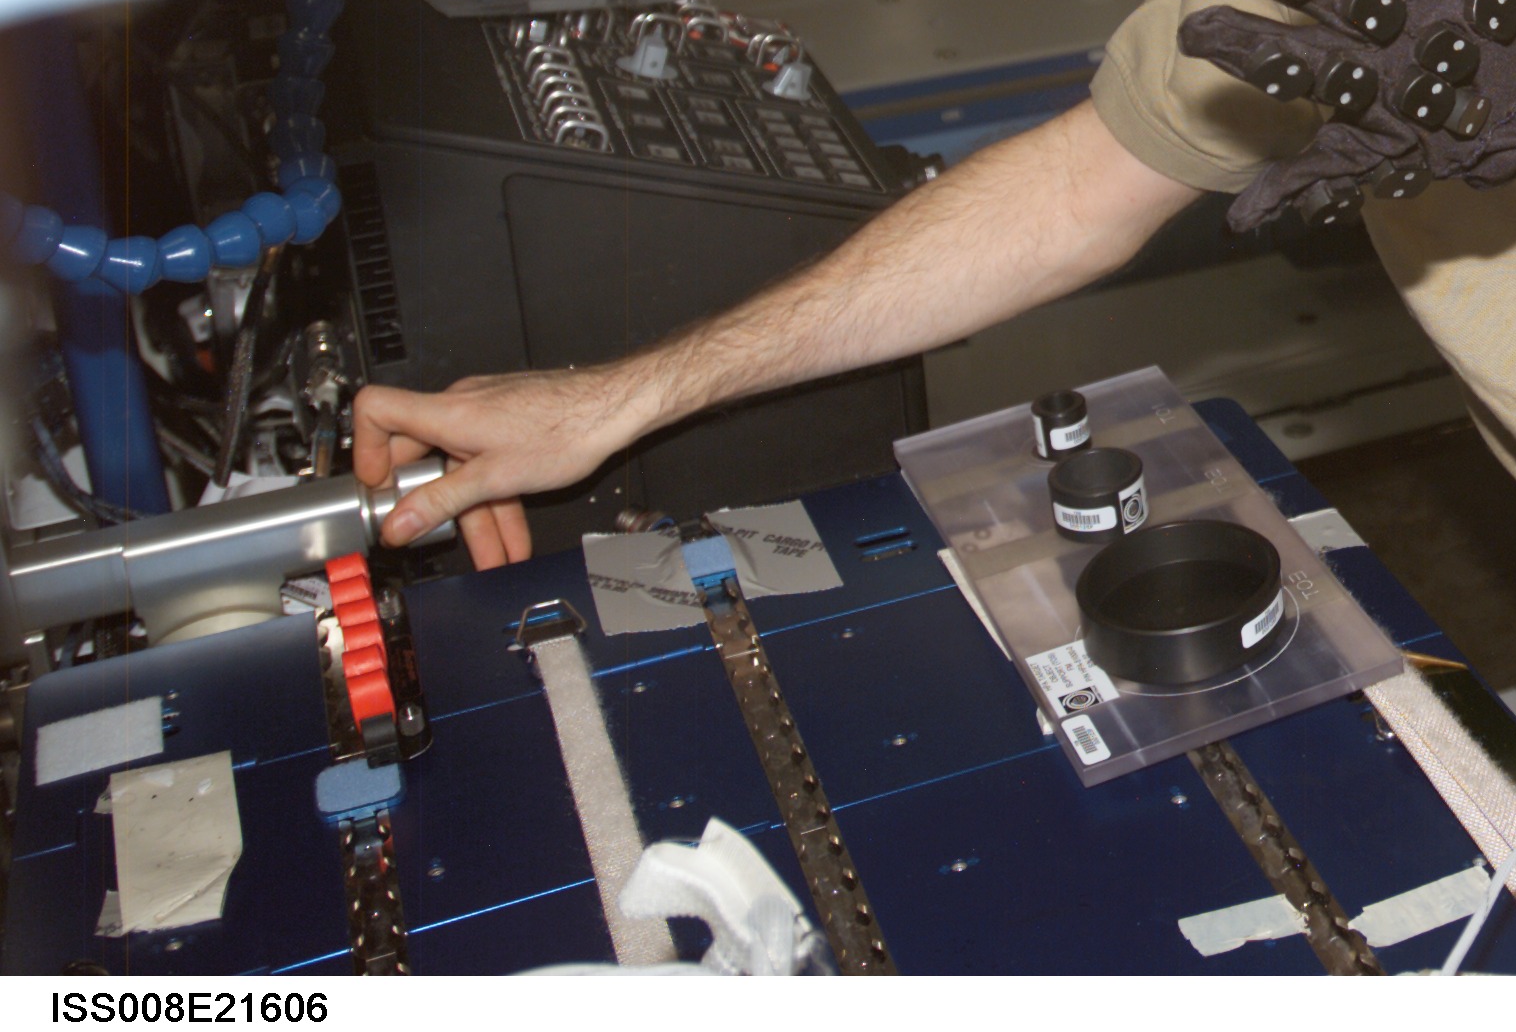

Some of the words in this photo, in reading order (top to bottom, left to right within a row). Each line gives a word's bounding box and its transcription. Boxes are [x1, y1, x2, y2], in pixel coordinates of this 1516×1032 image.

[734, 528, 760, 539] PIT
[762, 533, 811, 549] CARGO
[772, 545, 809, 558] TAPE
